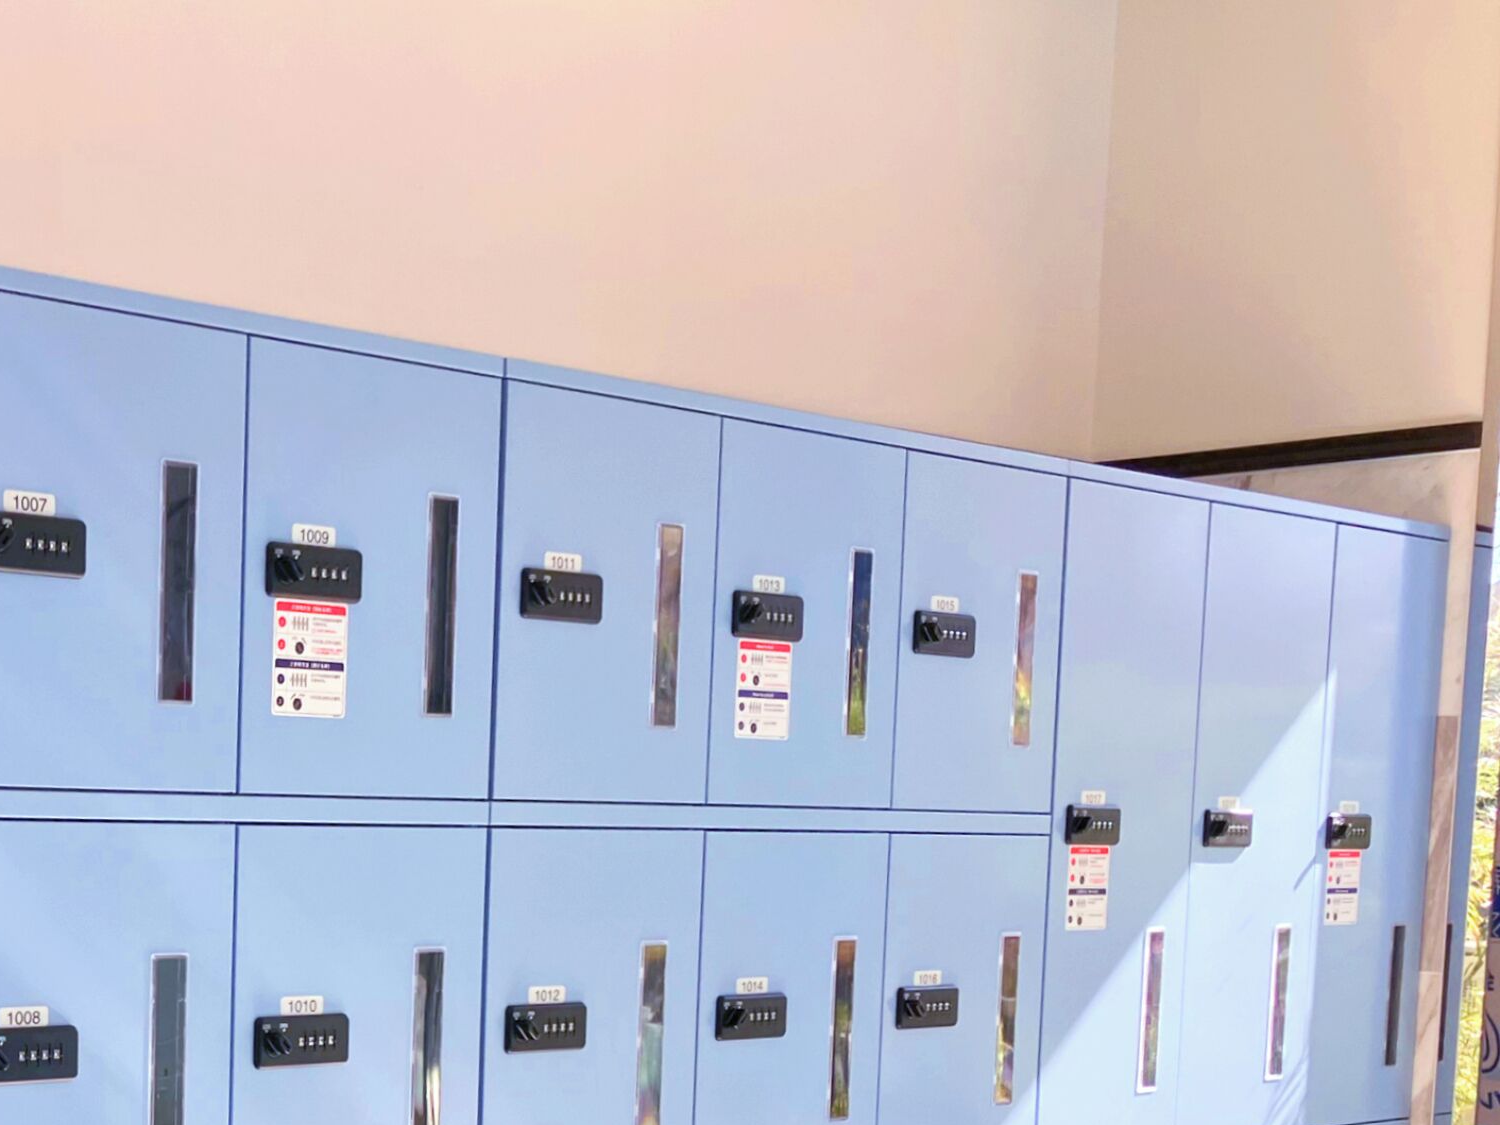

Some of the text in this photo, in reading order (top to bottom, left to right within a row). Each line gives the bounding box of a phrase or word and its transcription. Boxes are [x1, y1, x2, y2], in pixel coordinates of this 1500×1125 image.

[14, 495, 47, 512] 1007
[300, 529, 329, 544] 1009
[552, 555, 575, 569] 1011
[759, 578, 780, 592] 1013
[535, 989, 560, 1001] 1012
[288, 1000, 317, 1013] 1010
[7, 1011, 41, 1025] 1008
